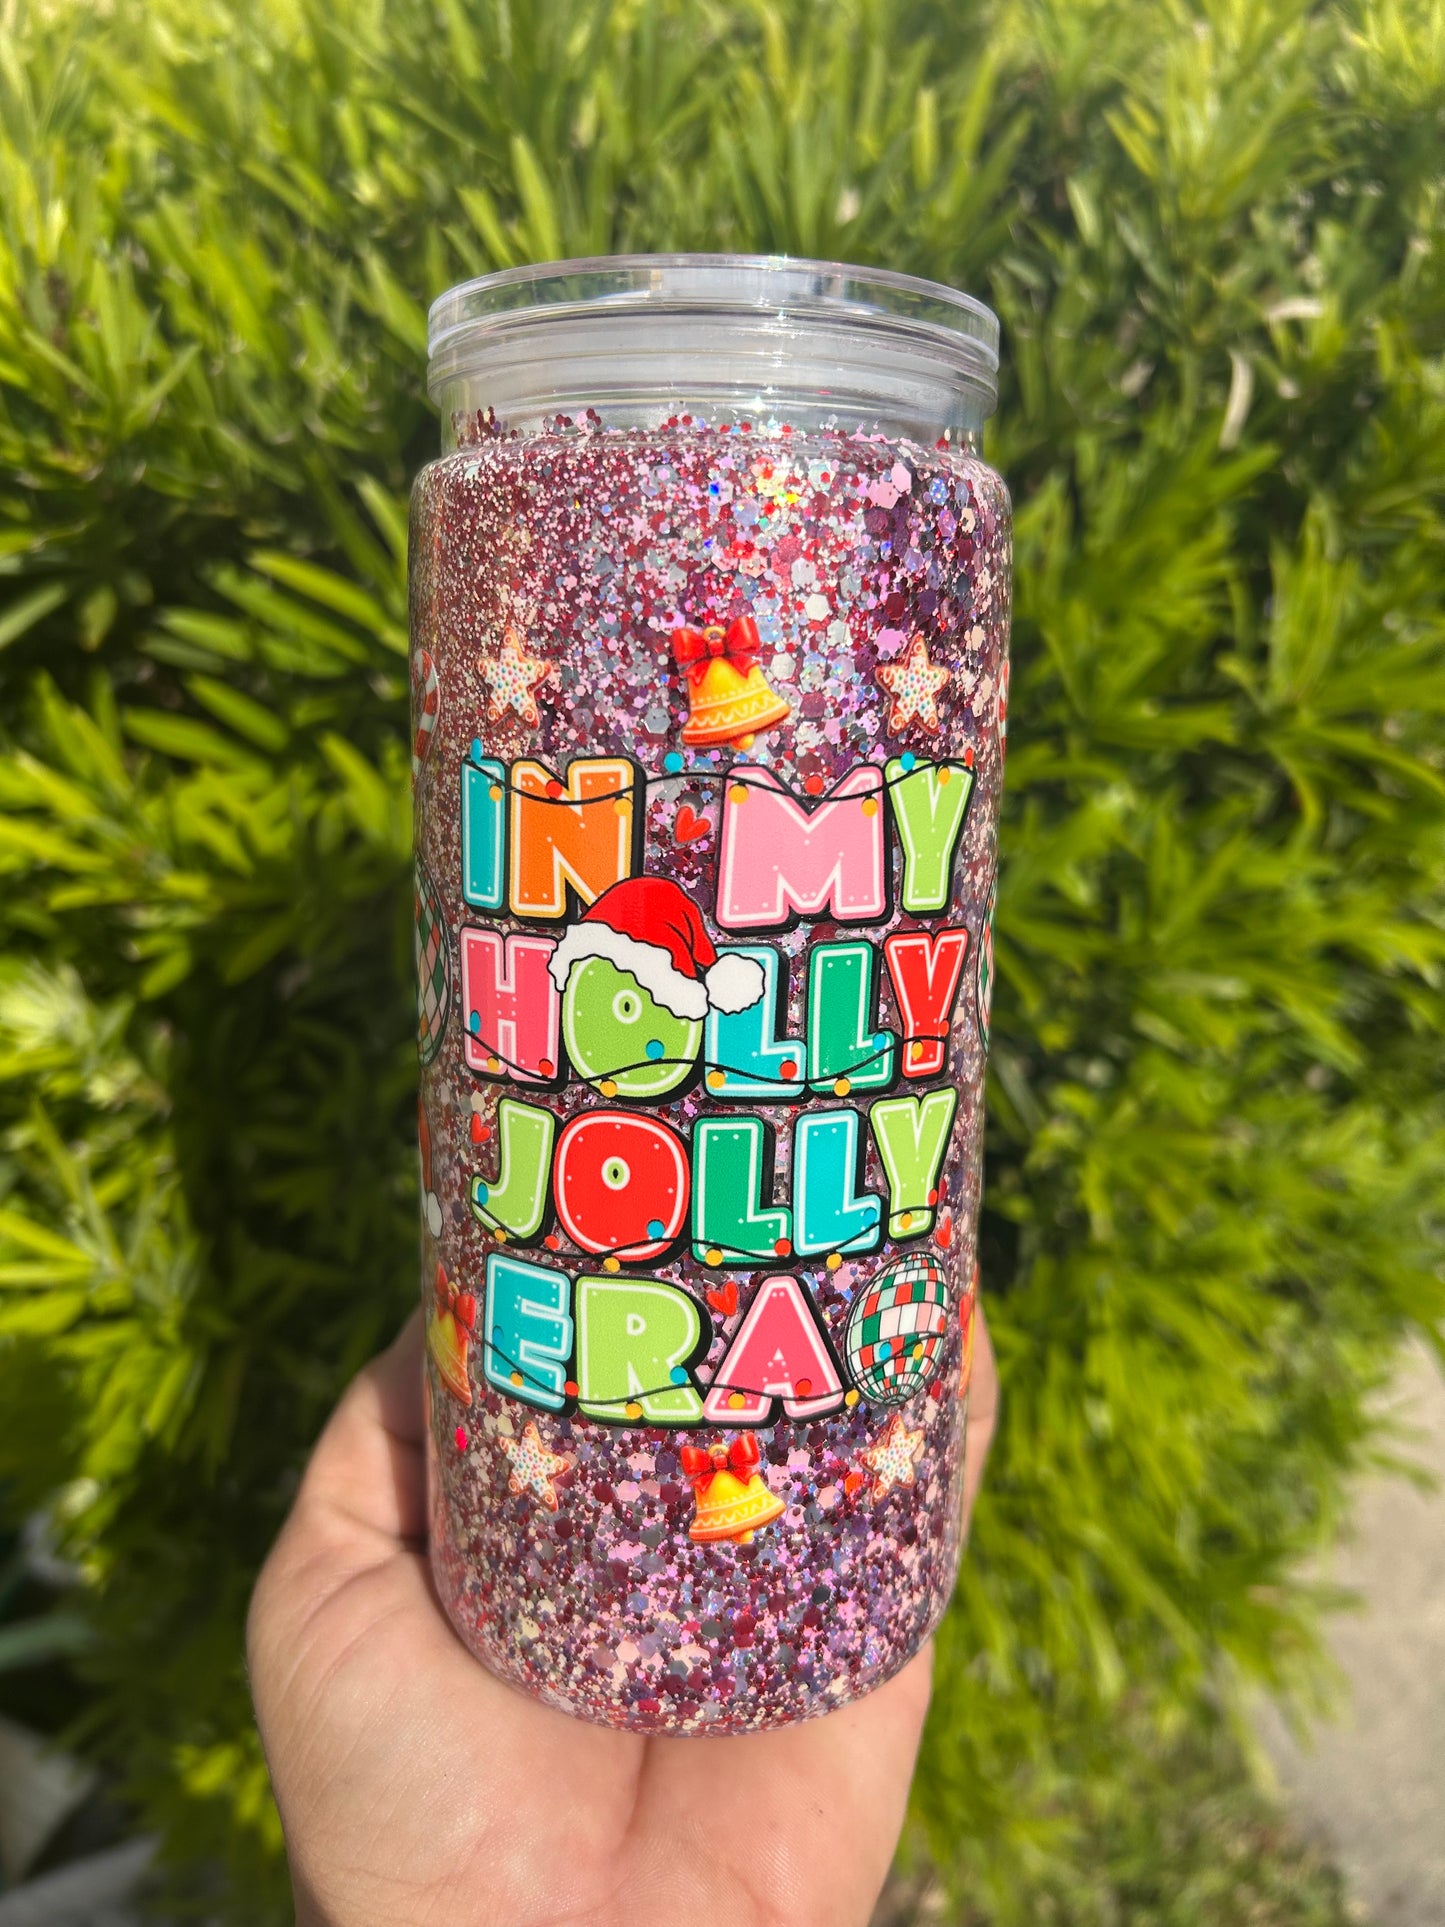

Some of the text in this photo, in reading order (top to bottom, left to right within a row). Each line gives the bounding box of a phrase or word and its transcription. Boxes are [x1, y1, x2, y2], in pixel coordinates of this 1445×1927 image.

[461, 755, 977, 934] IN MY
[460, 924, 970, 1105] HOLLY
[471, 1086, 958, 1270] JOLLY
[483, 1252, 848, 1429] ERA
